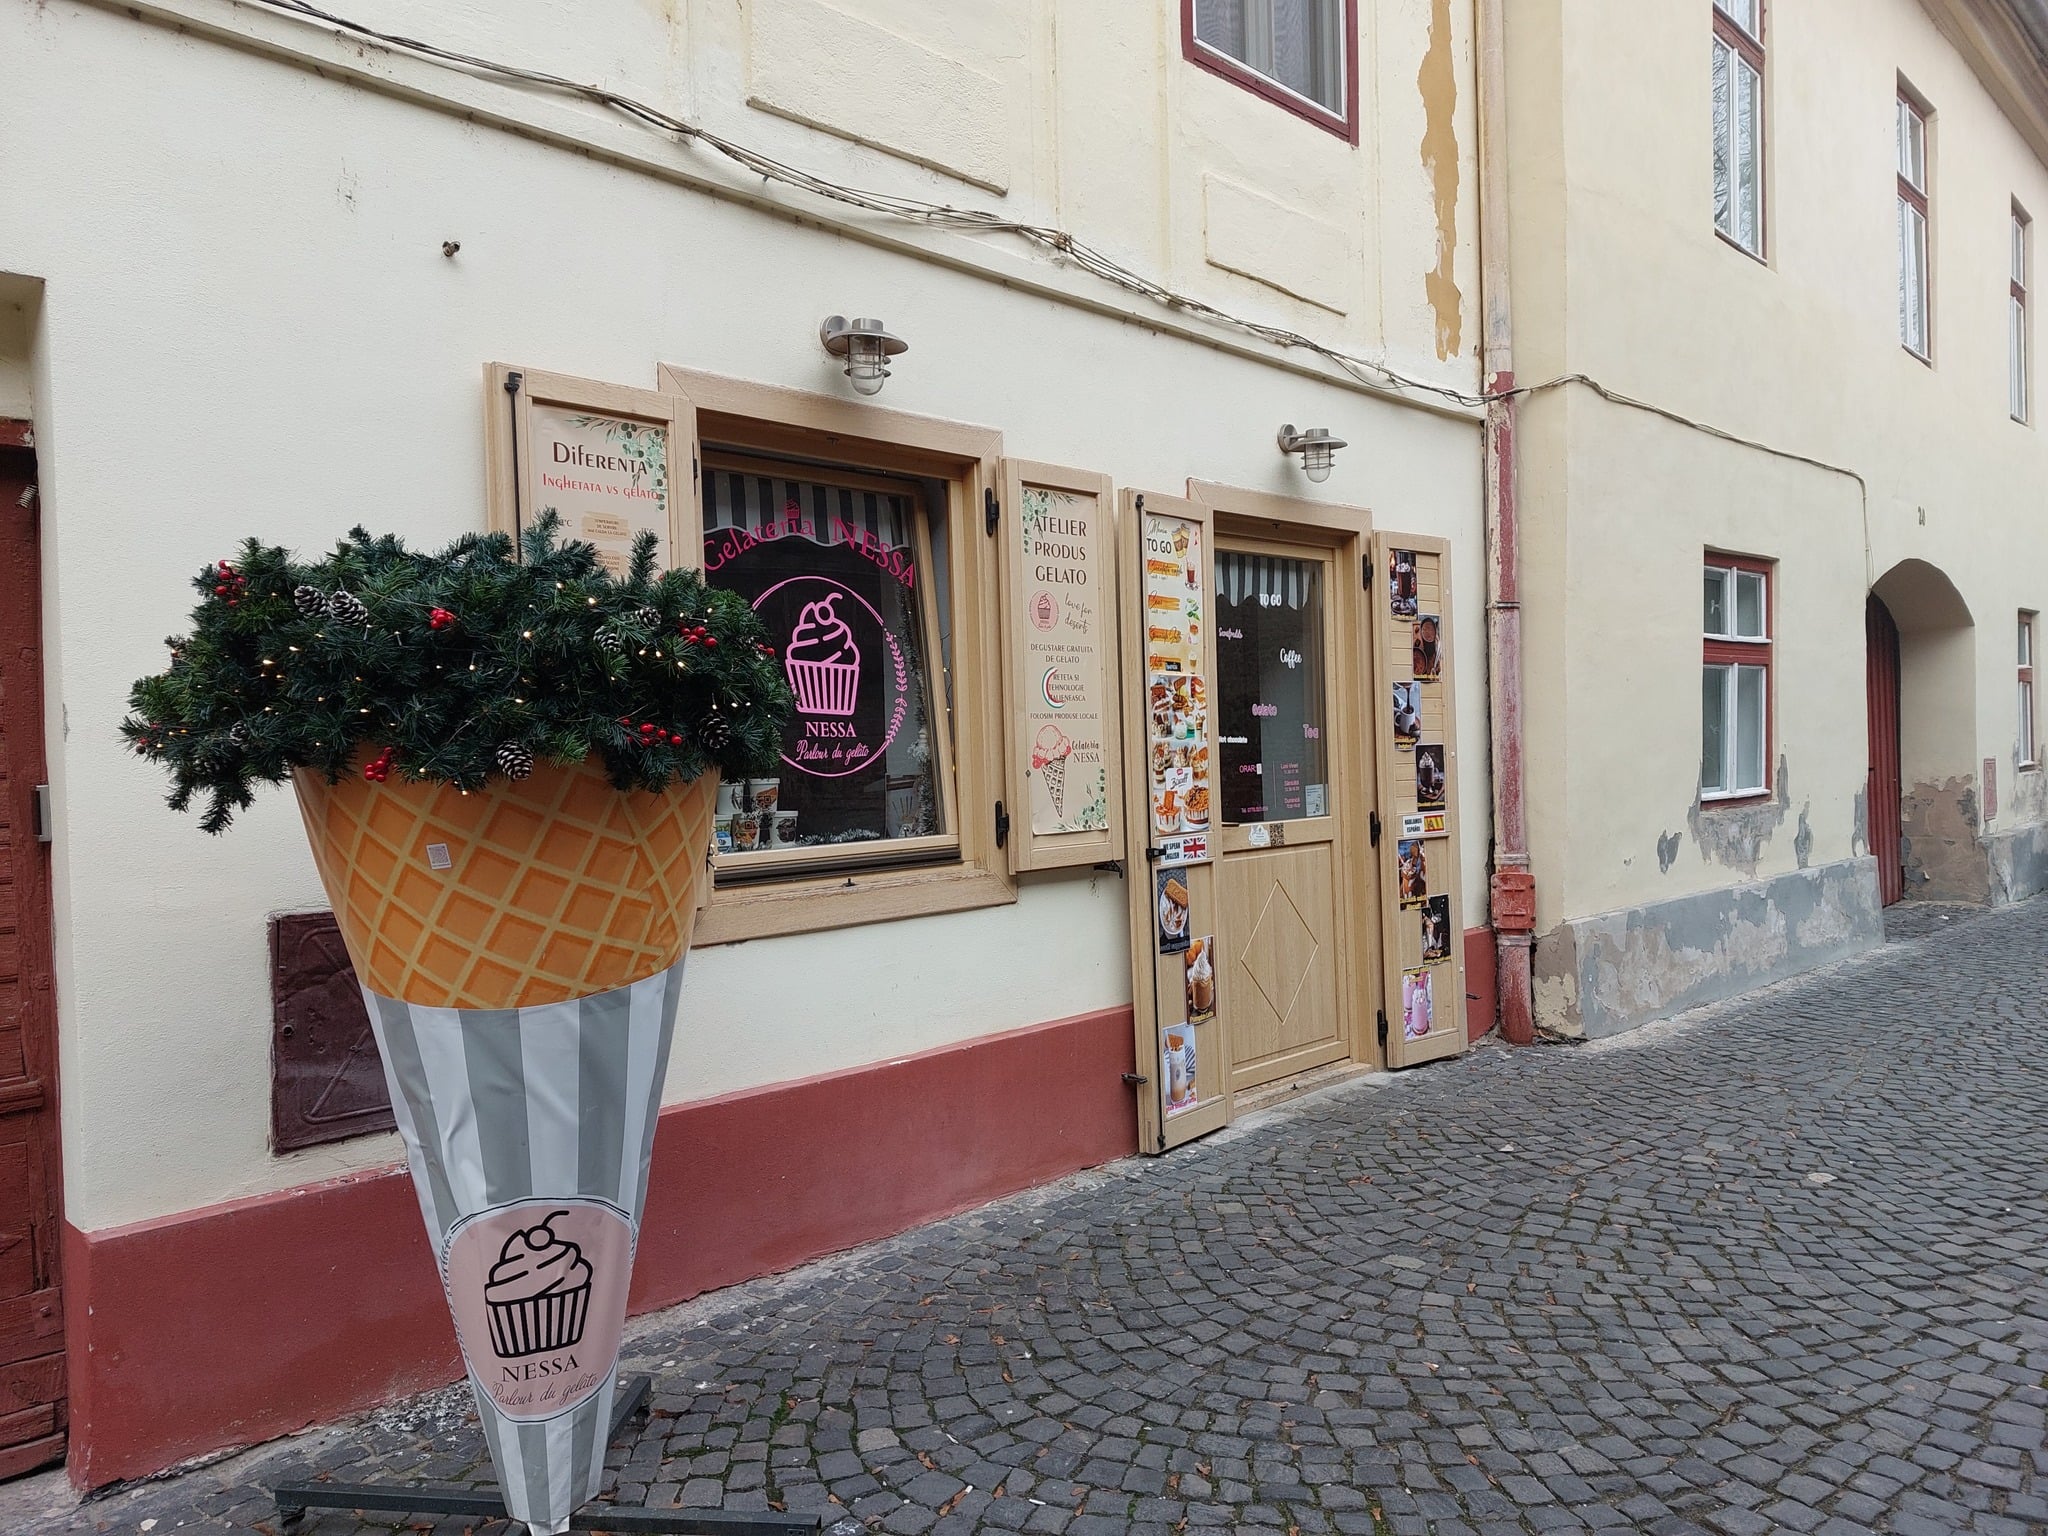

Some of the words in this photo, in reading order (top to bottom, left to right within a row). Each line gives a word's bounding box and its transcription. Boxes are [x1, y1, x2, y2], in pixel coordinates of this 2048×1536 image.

[1034, 515, 1087, 537] ATELIER
[704, 518, 815, 571] Gelateria
[832, 516, 914, 588] NESSA
[1035, 541, 1086, 561] PRODUS
[1146, 538, 1158, 552] TO
[1160, 540, 1172, 554] GO
[1035, 565, 1087, 585] GELATO
[1259, 593, 1270, 606] TO
[1270, 594, 1282, 607] GO
[1030, 643, 1065, 653] DEGUSTARE
[1066, 645, 1093, 653] GRATUITA
[1045, 655, 1054, 663] DE
[1055, 655, 1080, 664] GELATO
[1280, 648, 1303, 669] Coffee
[1252, 703, 1278, 716] Gelato
[805, 721, 857, 738] NESSA
[1303, 723, 1319, 739] Tea
[796, 739, 829, 761] Parlour
[832, 742, 842, 759] du
[1073, 751, 1100, 764] NESSA
[501, 1353, 580, 1383] NESSA
[491, 1382, 534, 1406] Parlour
[539, 1382, 556, 1402] du
